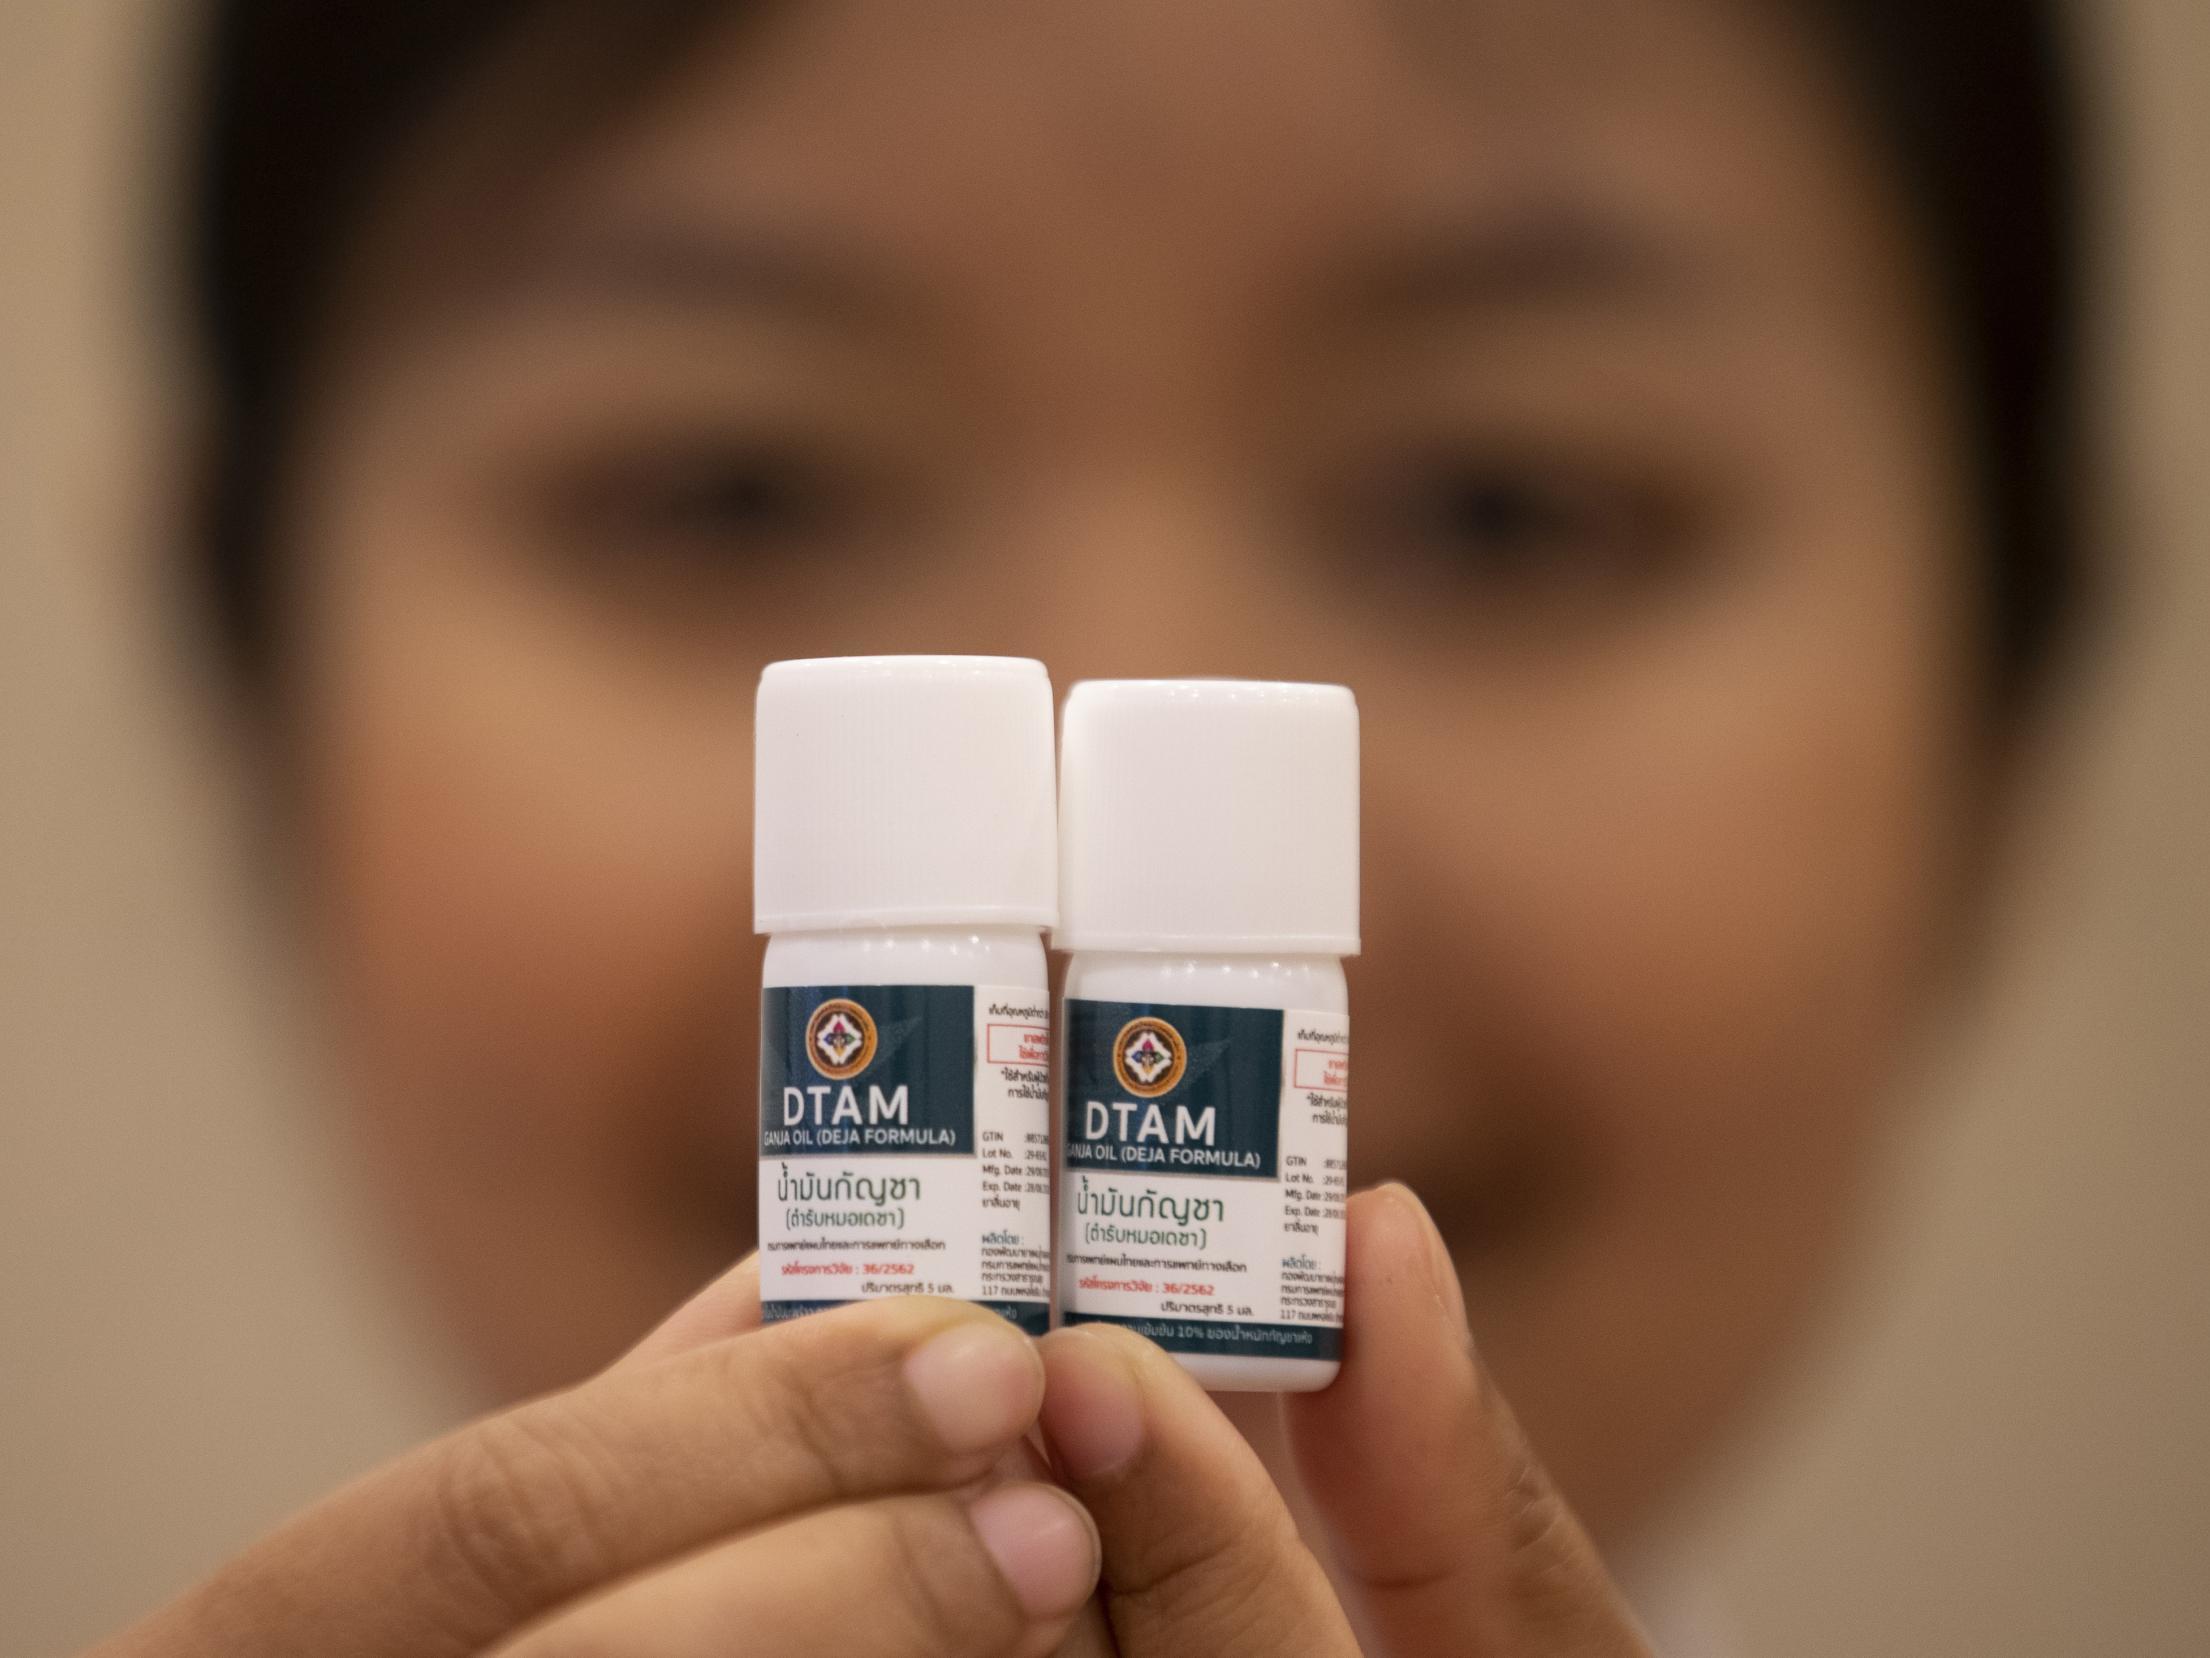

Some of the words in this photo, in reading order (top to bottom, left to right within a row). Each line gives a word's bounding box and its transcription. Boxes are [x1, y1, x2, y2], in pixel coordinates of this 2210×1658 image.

[783, 1085, 909, 1126] DTAM
[1085, 1100, 1217, 1146] DTAM
[764, 1129, 791, 1147] GANJA
[793, 1129, 813, 1146] OIL
[816, 1128, 860, 1146] (DEJA
[864, 1128, 956, 1146] FORMULA)
[982, 1131, 1004, 1142] GTIN
[982, 1148, 996, 1159] Lot
[1095, 1144, 1118, 1161] OIL
[1120, 1146, 1165, 1164] (DEJA
[1169, 1148, 1262, 1169] FORMULA)
[1286, 1155, 1307, 1167] GTIN
[1004, 1165, 1022, 1176] Date
[1285, 1172, 1300, 1183] Lot
[777, 1162, 921, 1207] น้ำมันกัญชา
[1003, 1181, 1022, 1192] Date
[1076, 1175, 1225, 1227] น้ำมันกัญชา
[785, 1207, 905, 1231] (ตำรับหมอเดชา)
[1084, 1221, 1208, 1250] (ตำรับหมอเดชา)
[863, 1263, 915, 1276] 36/2562
[861, 1281, 924, 1296] ปริมาตรสุทธิ
[928, 1283, 934, 1293] 5
[1162, 1282, 1215, 1297] 36/2562
[1160, 1300, 1224, 1317] ปริมาตรสุทธิ
[1226, 1304, 1233, 1316] 5
[1177, 1325, 1205, 1340] 10%
